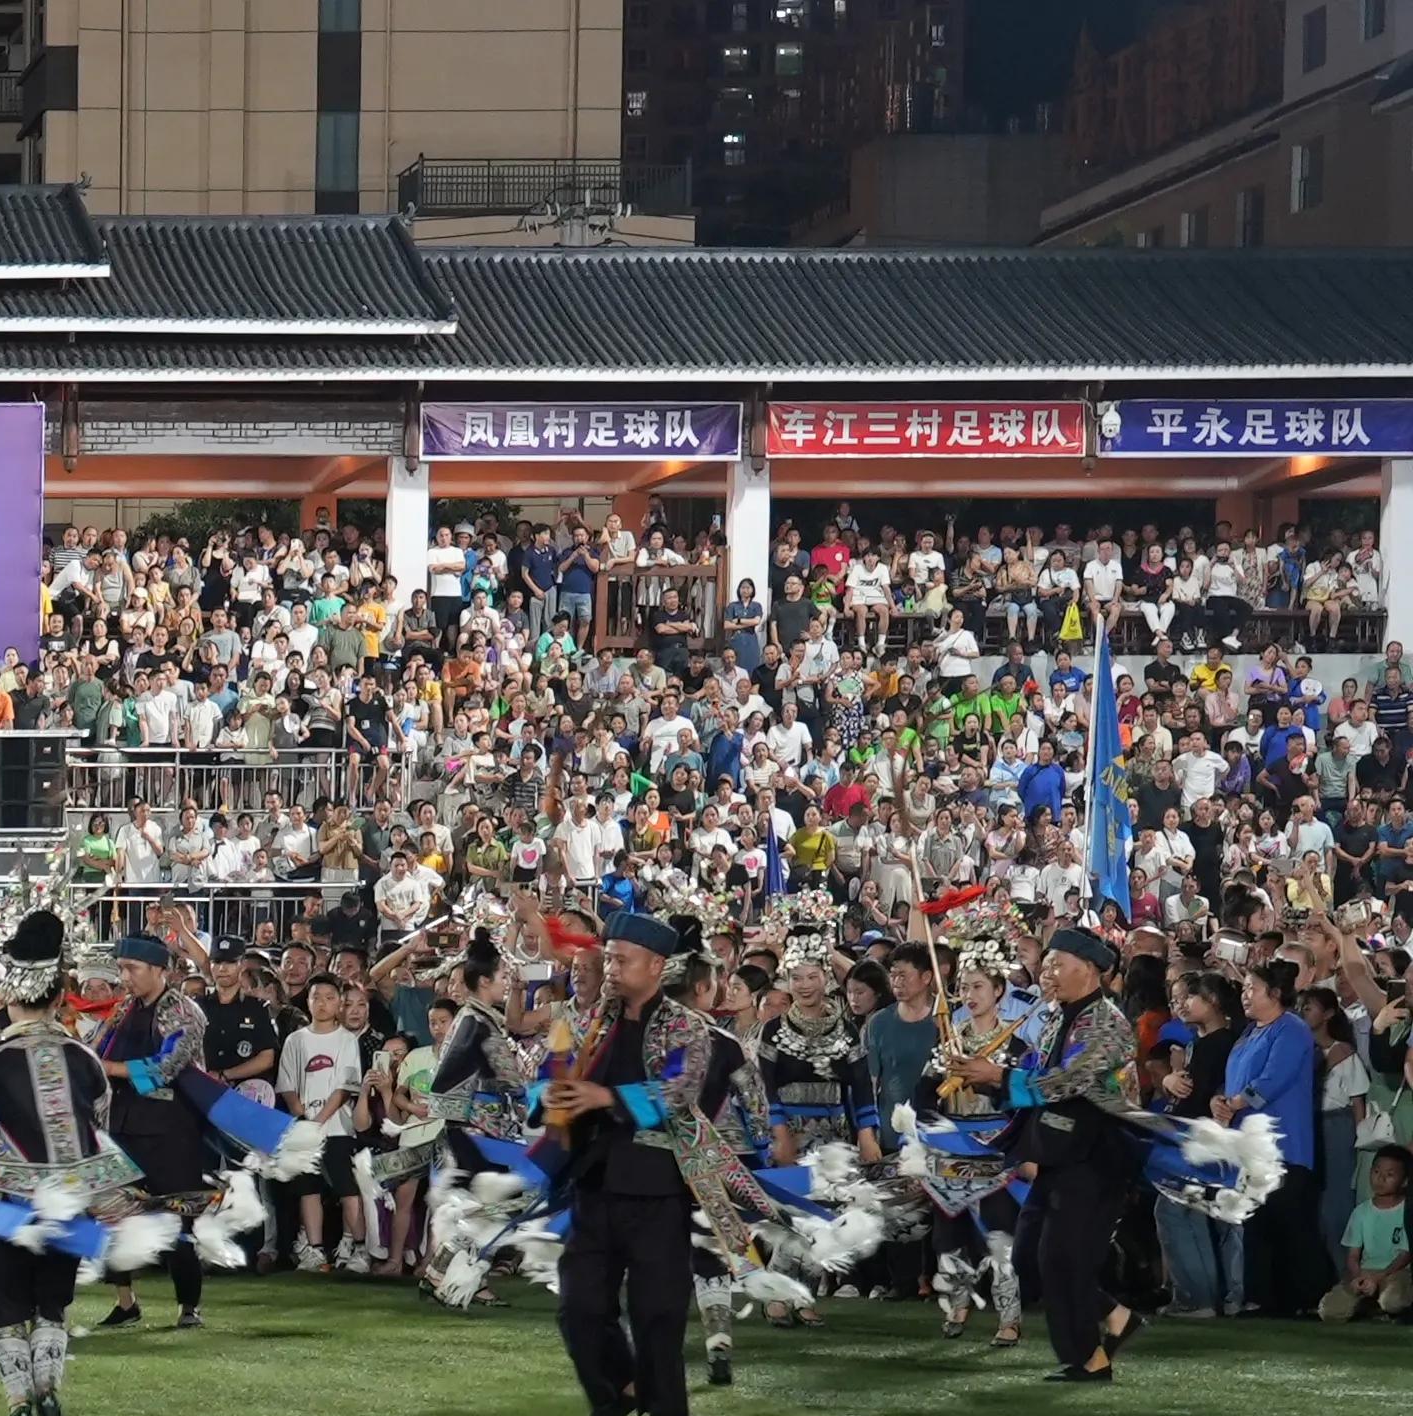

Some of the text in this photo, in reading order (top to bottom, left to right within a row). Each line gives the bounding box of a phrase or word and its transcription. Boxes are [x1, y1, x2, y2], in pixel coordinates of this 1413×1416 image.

[461, 409, 700, 449] 凤凰村足球队
[779, 408, 1068, 447] 车江三村足球队
[1146, 407, 1371, 447] 平永足球队
